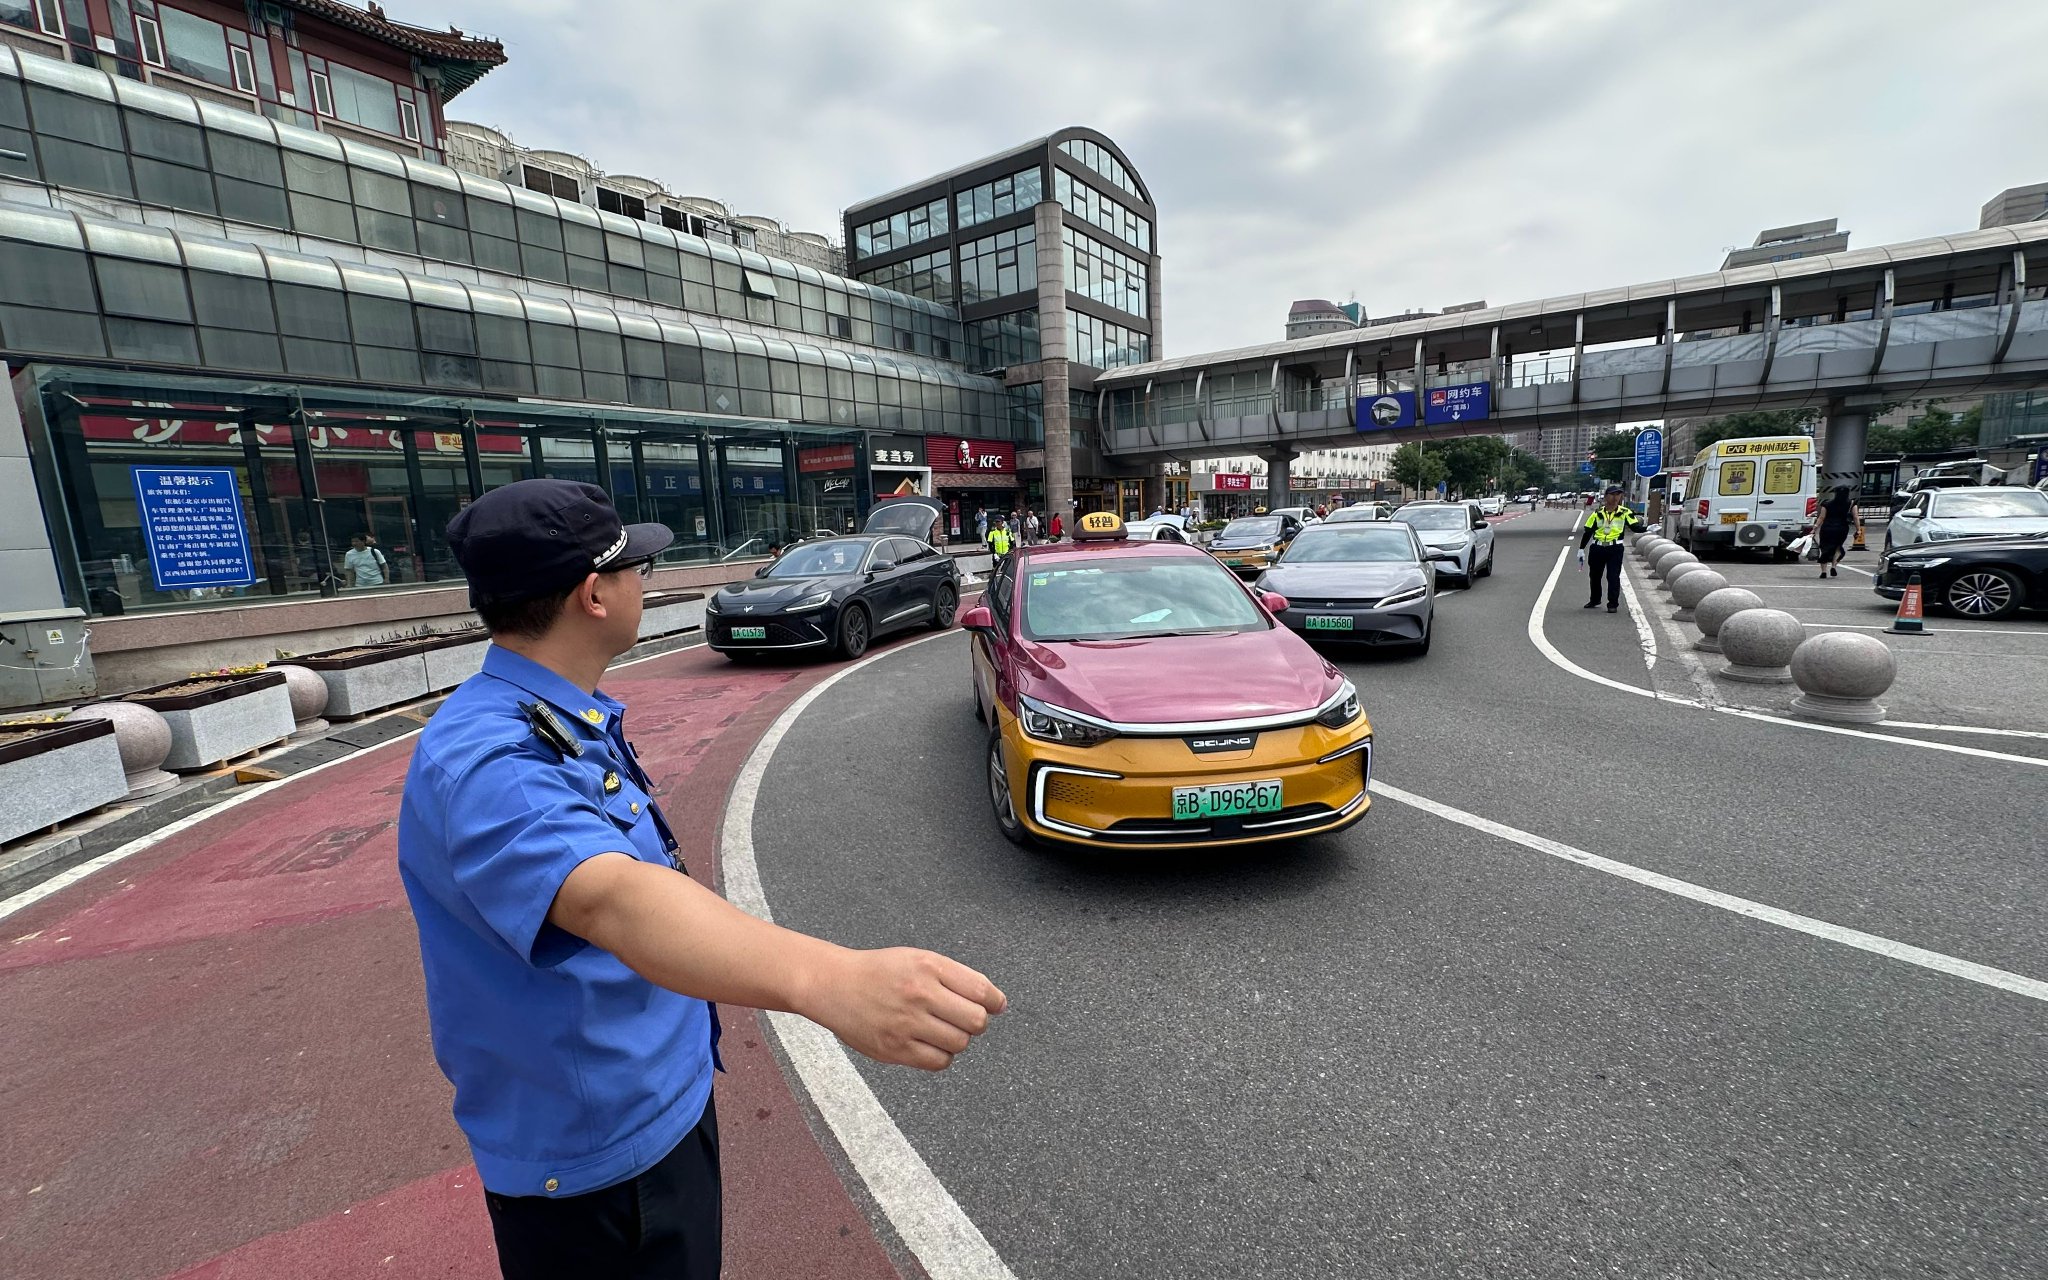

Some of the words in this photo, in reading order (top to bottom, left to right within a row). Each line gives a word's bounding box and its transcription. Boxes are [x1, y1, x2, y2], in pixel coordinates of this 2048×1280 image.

[1447, 386, 1482, 399] 网约车
[1727, 445, 1746, 454] CAR
[1749, 442, 1800, 453] 神州租车
[875, 449, 914, 463] 麦当劳
[979, 454, 1003, 468] KFC
[160, 475, 214, 486] 温馨提示
[1089, 516, 1114, 528] 轻普
[1192, 737, 1251, 748] BEIJING
